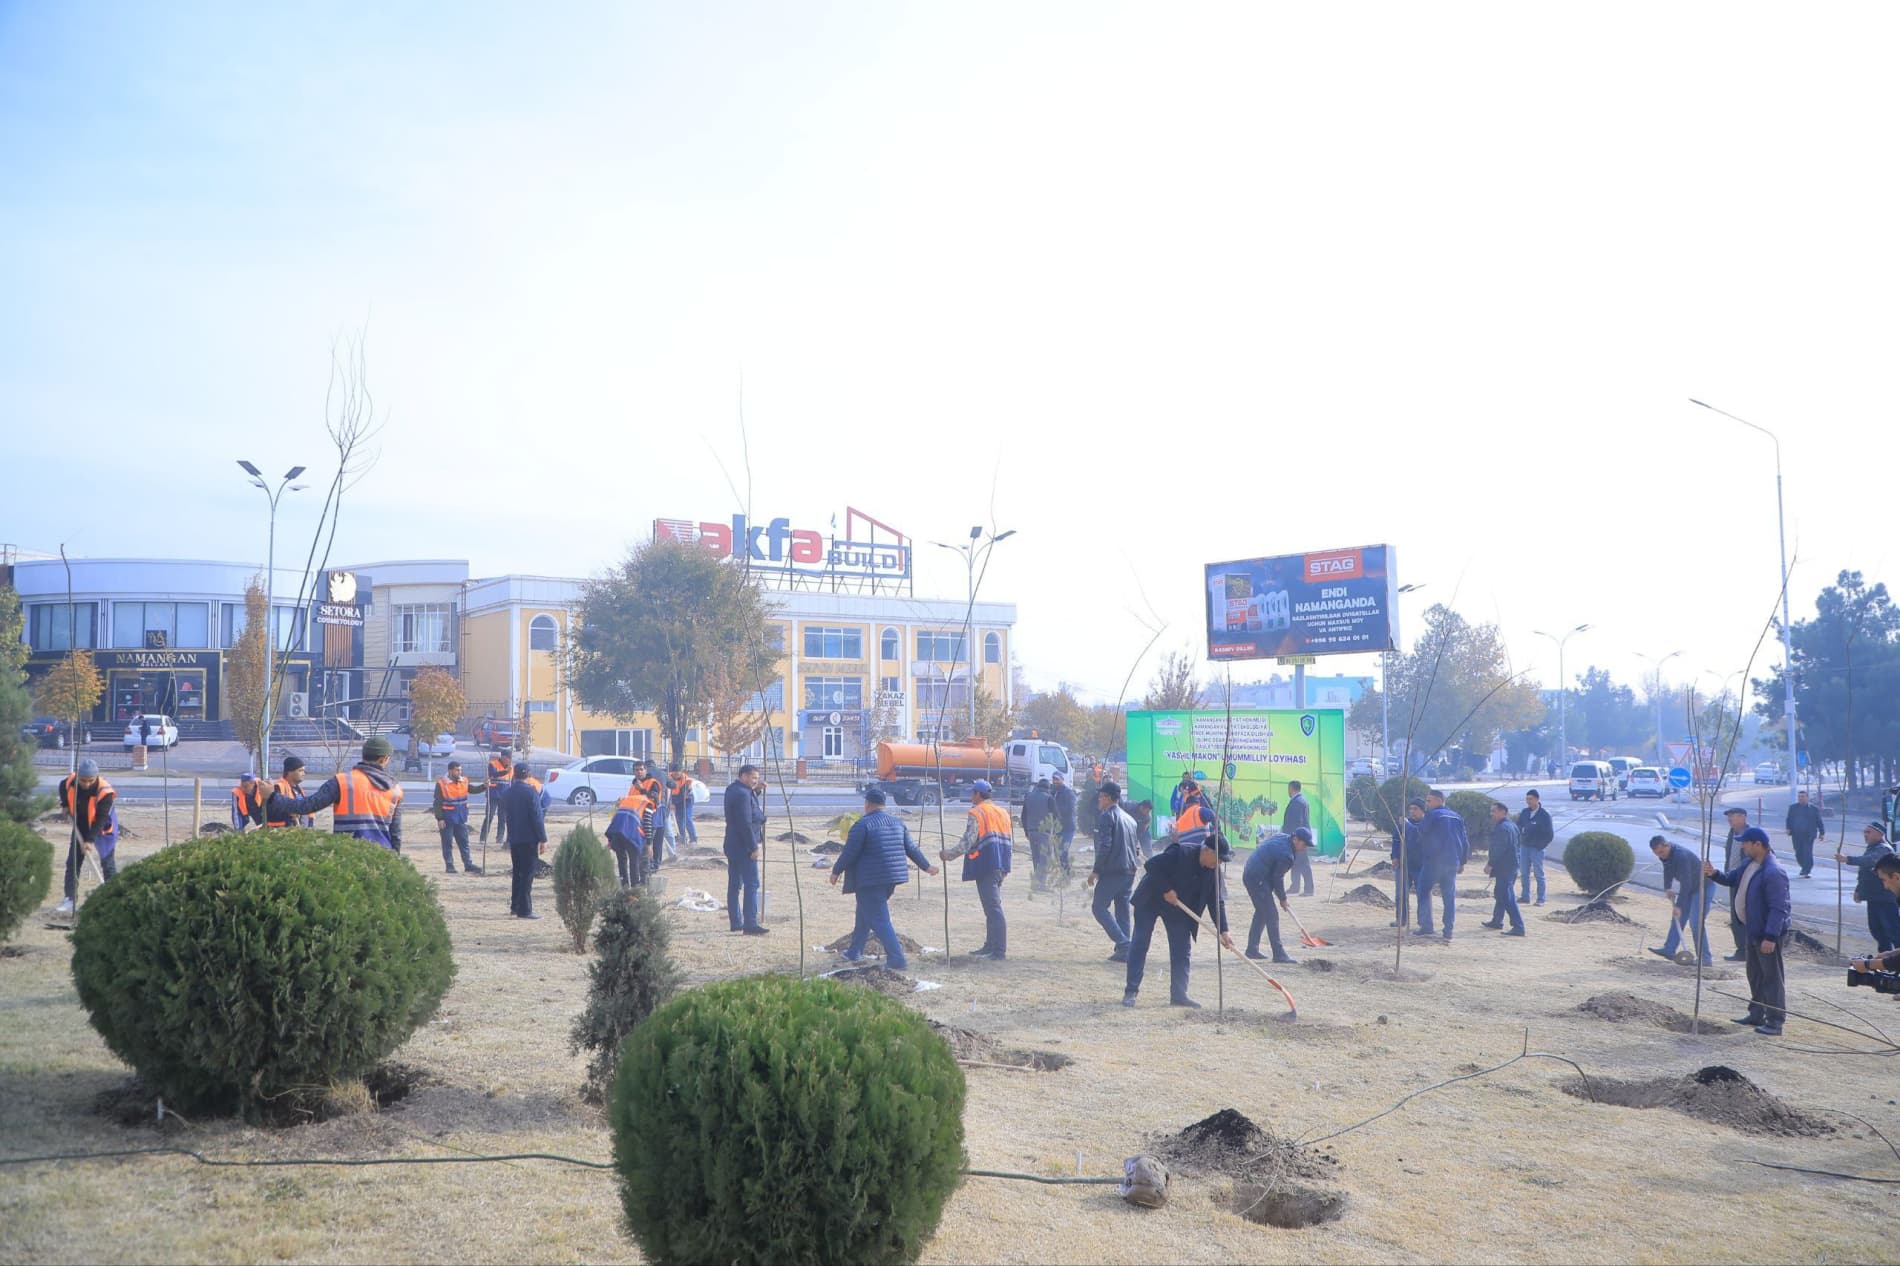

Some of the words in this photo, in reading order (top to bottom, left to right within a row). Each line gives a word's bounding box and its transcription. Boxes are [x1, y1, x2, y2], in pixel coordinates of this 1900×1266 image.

[700, 514, 823, 564] akfa
[828, 550, 897, 568] BUILD
[1310, 559, 1354, 574] STAG
[1321, 587, 1348, 599] ENDI
[320, 605, 361, 618] SETORA
[1295, 597, 1377, 613] NAMANGANDA
[116, 653, 197, 664] NAMANGAN
[1269, 754, 1306, 764] LOYIHASI
